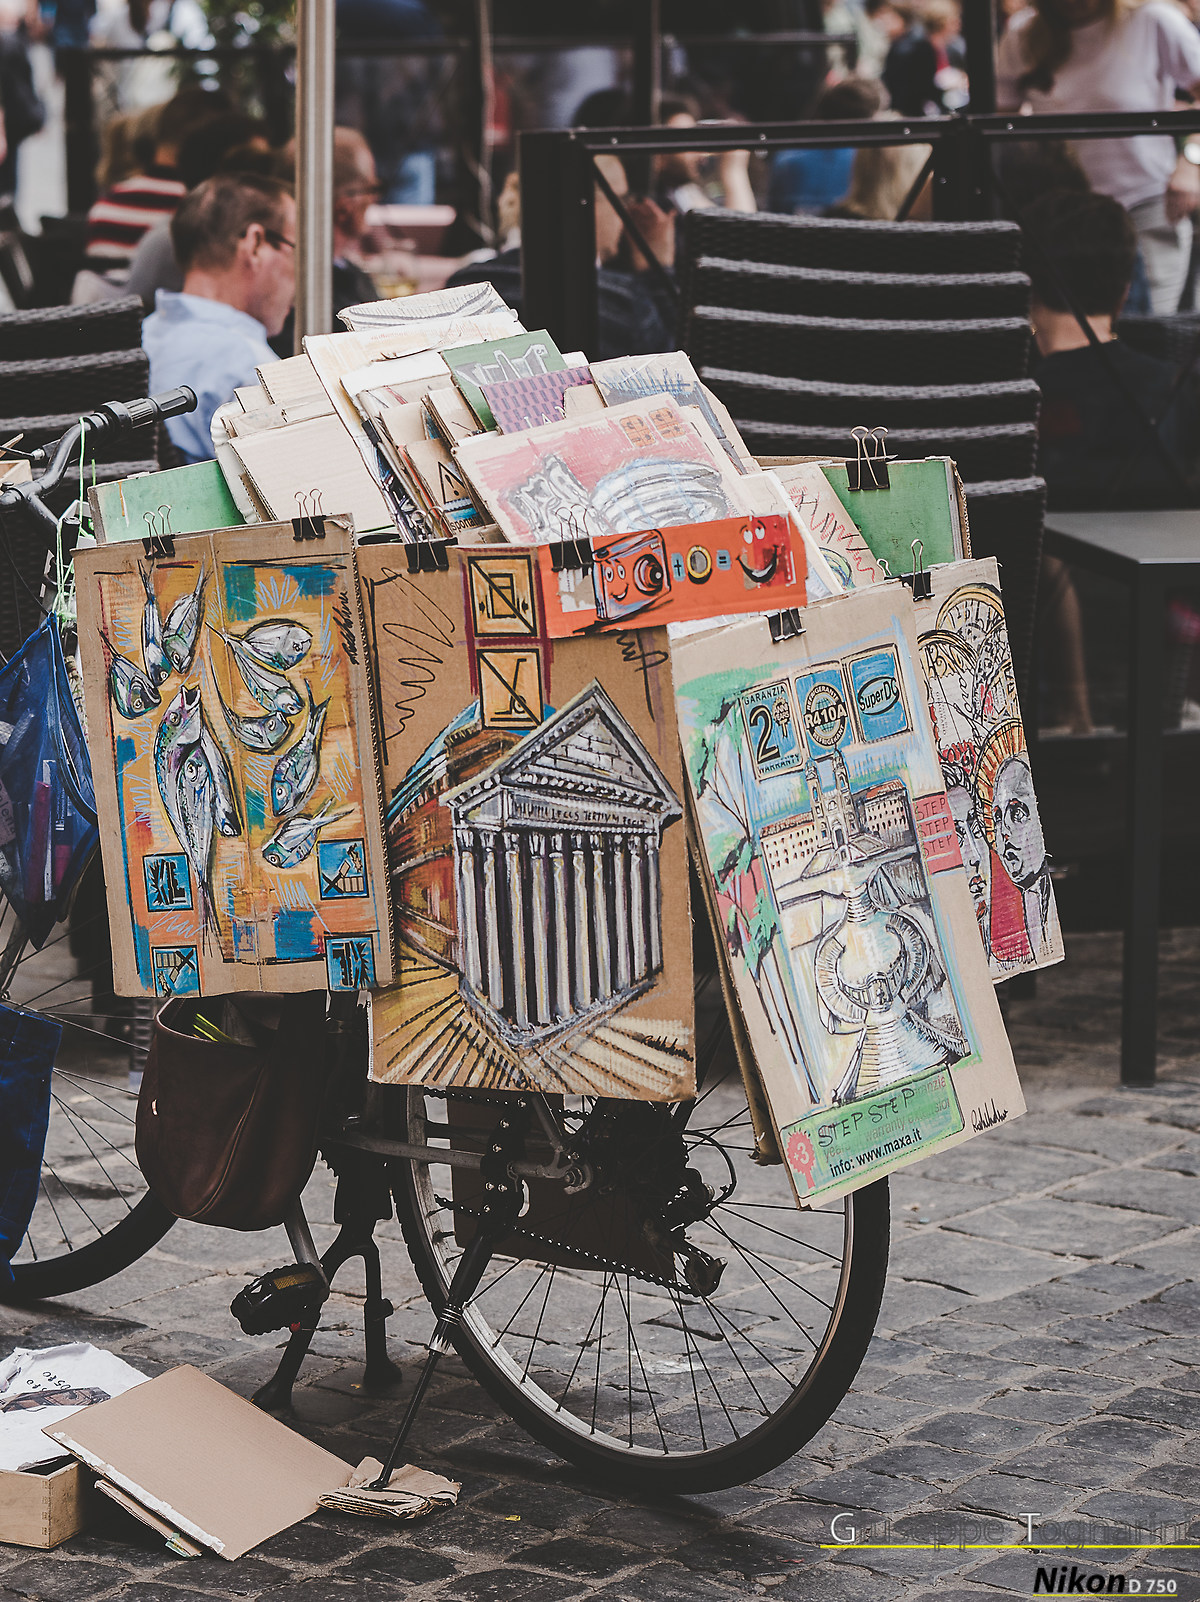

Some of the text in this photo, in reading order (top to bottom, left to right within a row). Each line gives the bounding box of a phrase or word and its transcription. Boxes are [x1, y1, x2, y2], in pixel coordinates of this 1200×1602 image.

[744, 685, 786, 706] GARANZIA
[804, 703, 847, 730] R410A
[915, 797, 946, 821] STEP
[919, 817, 949, 839] STEP
[923, 835, 952, 856] STEP
[818, 1088, 915, 1147] STEP STEP
[830, 1128, 922, 1177] info: www.maxa.it
